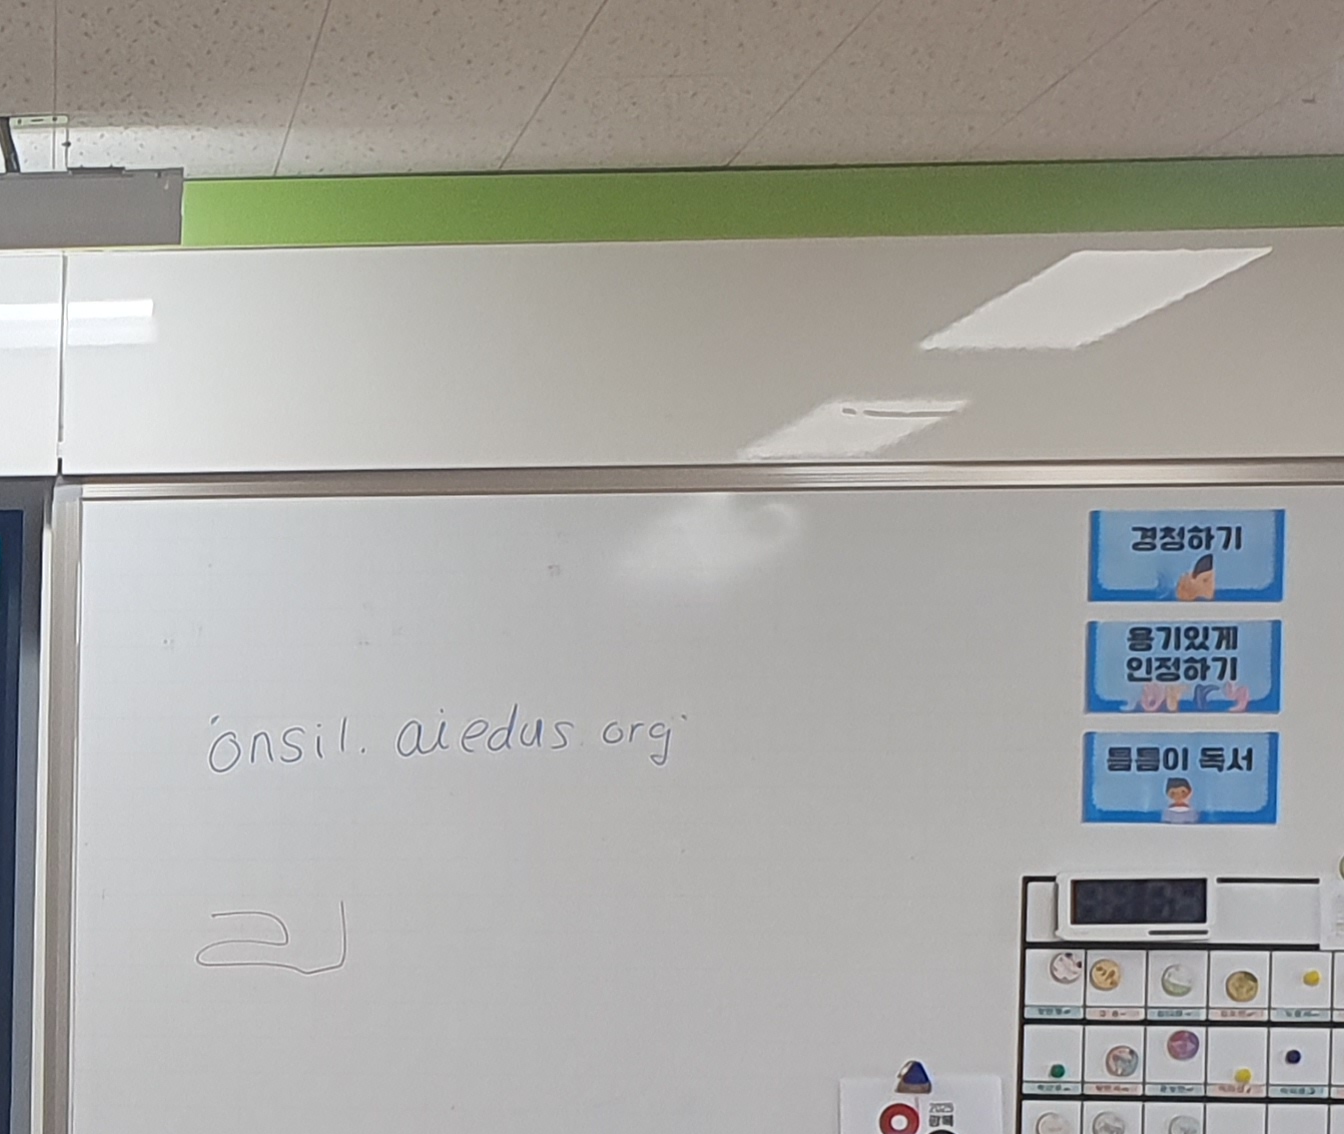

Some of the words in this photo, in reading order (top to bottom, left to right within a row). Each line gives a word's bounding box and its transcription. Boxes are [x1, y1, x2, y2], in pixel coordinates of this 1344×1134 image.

[1131, 526, 1242, 551] 경청하기
[1127, 626, 1238, 652] 용기있게
[1126, 657, 1238, 682] 인정하기
[1107, 747, 1189, 772] 틈틈이
[1199, 747, 1254, 773] 독서
